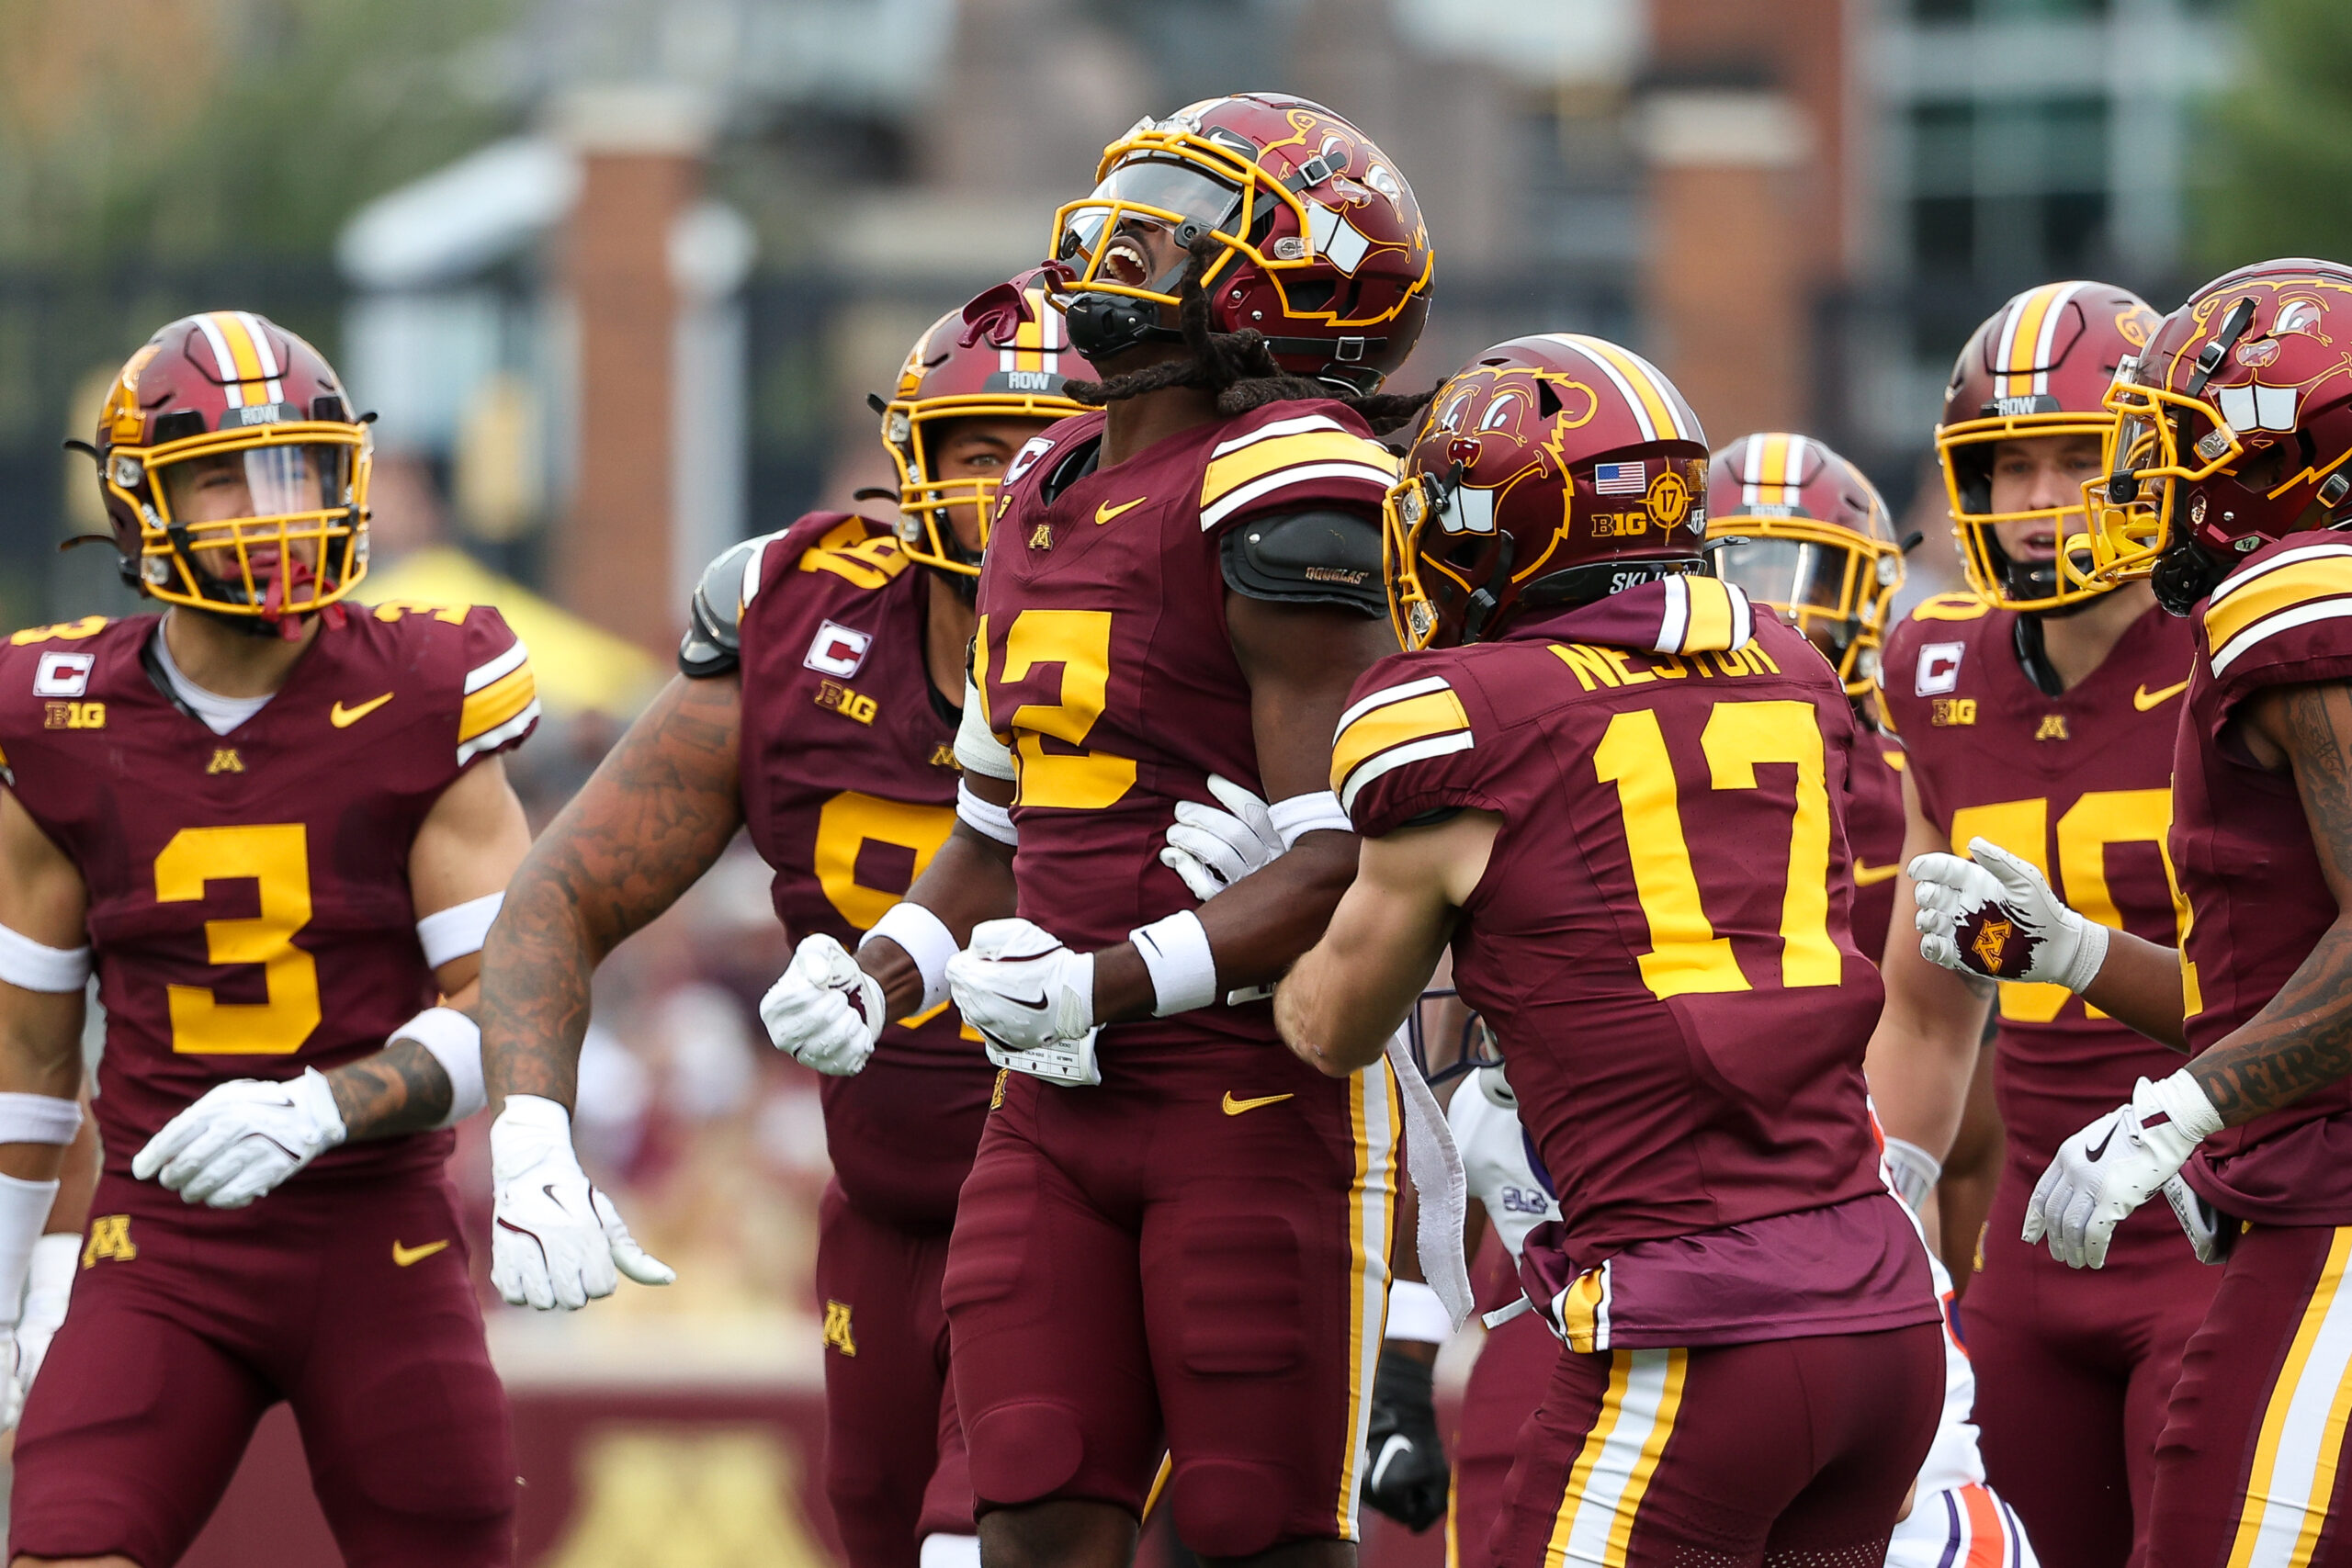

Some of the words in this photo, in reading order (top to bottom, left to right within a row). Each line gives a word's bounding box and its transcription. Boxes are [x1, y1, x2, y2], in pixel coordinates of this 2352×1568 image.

[1008, 371, 1050, 390] ROW
[240, 404, 280, 425] ROW
[1998, 396, 2037, 416] ROW
[1660, 489, 1678, 513] 17
[1305, 567, 1363, 584] DOUGLAS
[809, 626, 865, 674] C
[1917, 644, 1962, 693] C
[37, 653, 93, 694] C
[972, 609, 1138, 810] 2
[1592, 700, 1842, 1001] 17
[154, 823, 322, 1055] 3
